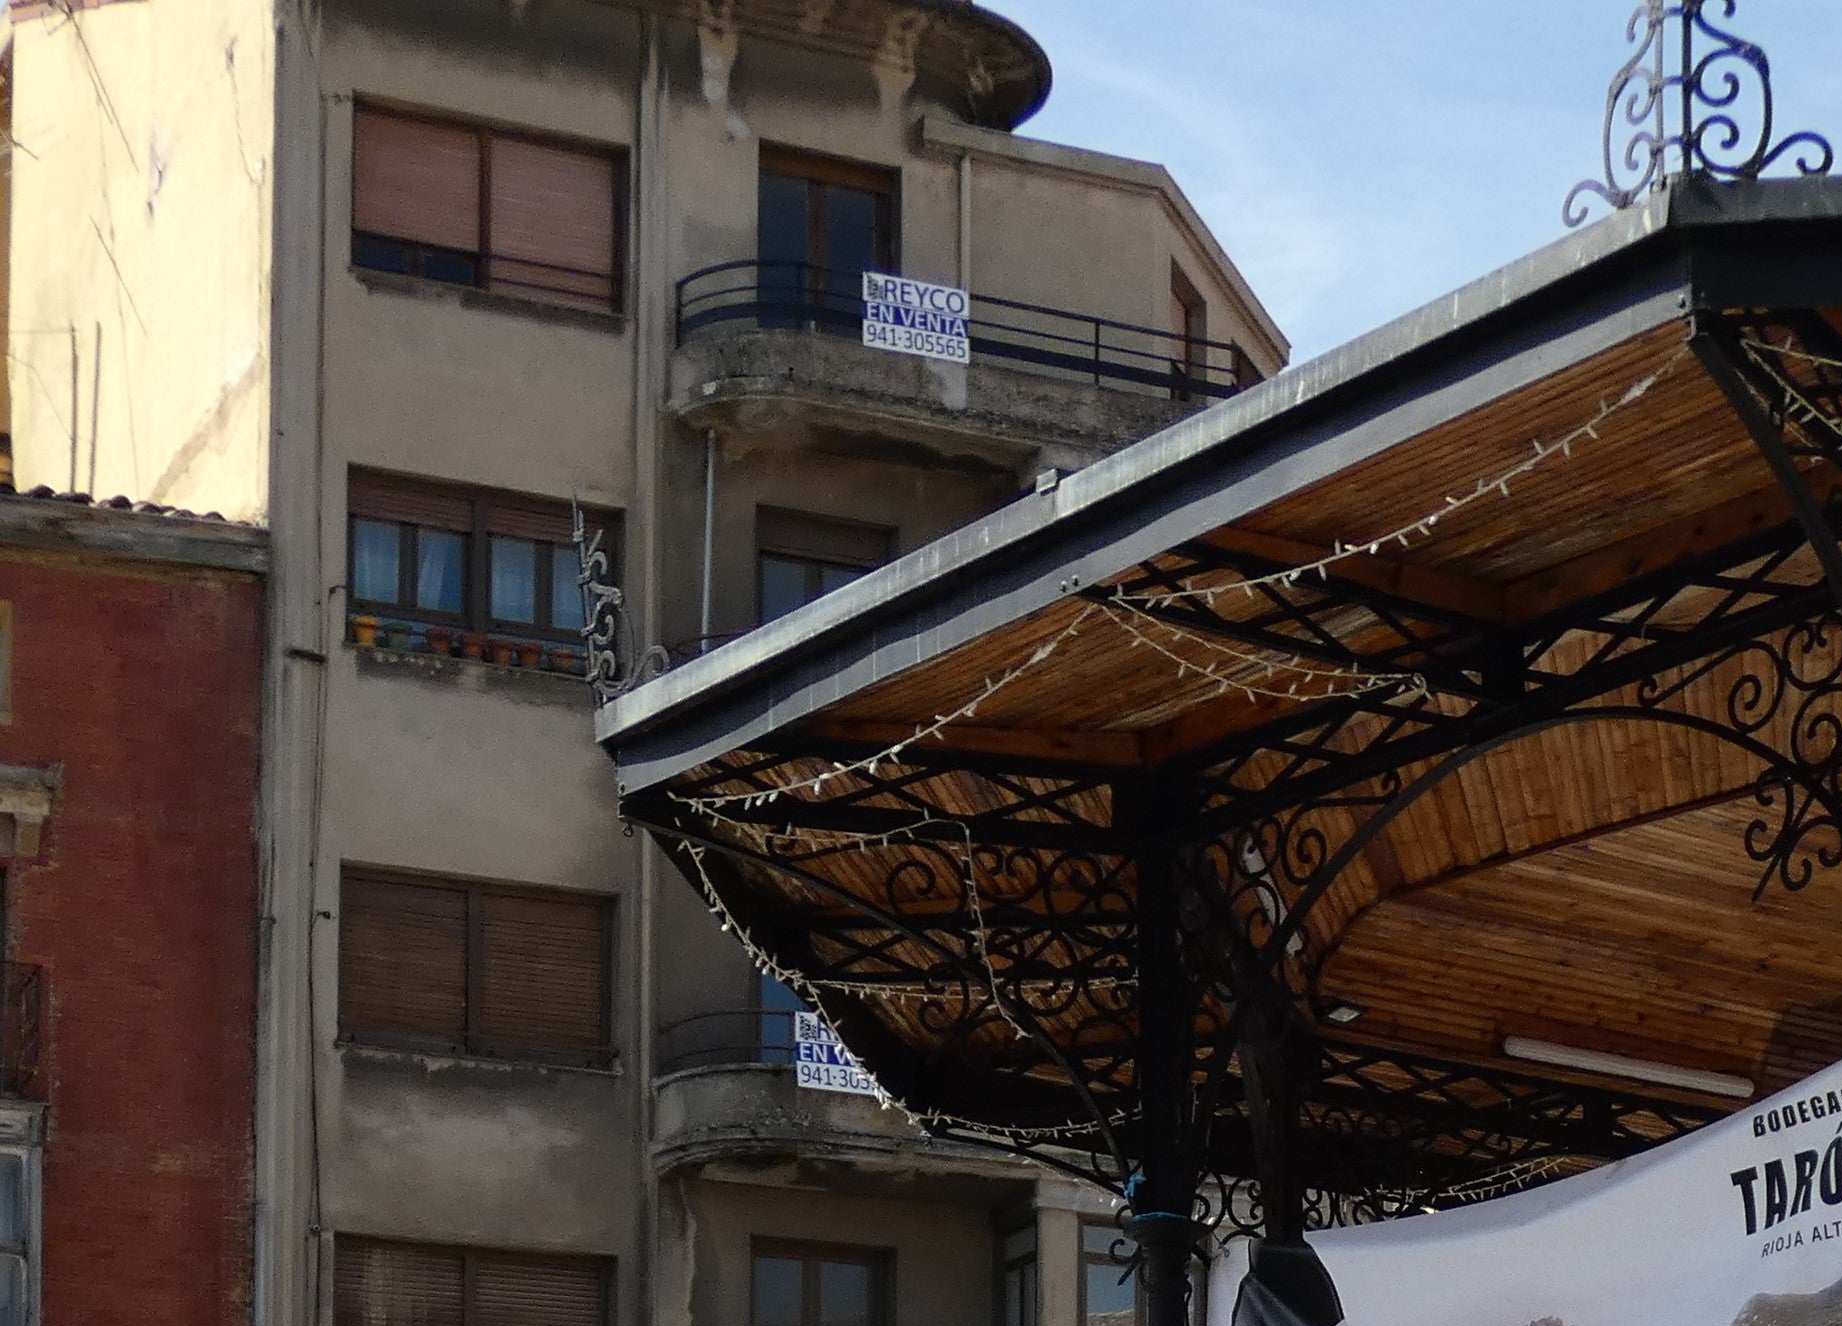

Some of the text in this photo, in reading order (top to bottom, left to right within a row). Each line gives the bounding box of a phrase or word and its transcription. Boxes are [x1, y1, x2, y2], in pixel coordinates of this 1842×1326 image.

[884, 279, 965, 314] REYCO
[865, 302, 968, 338] EN VENTA
[799, 1043, 825, 1063] EN
[1760, 1229, 1806, 1259] RIOJA
